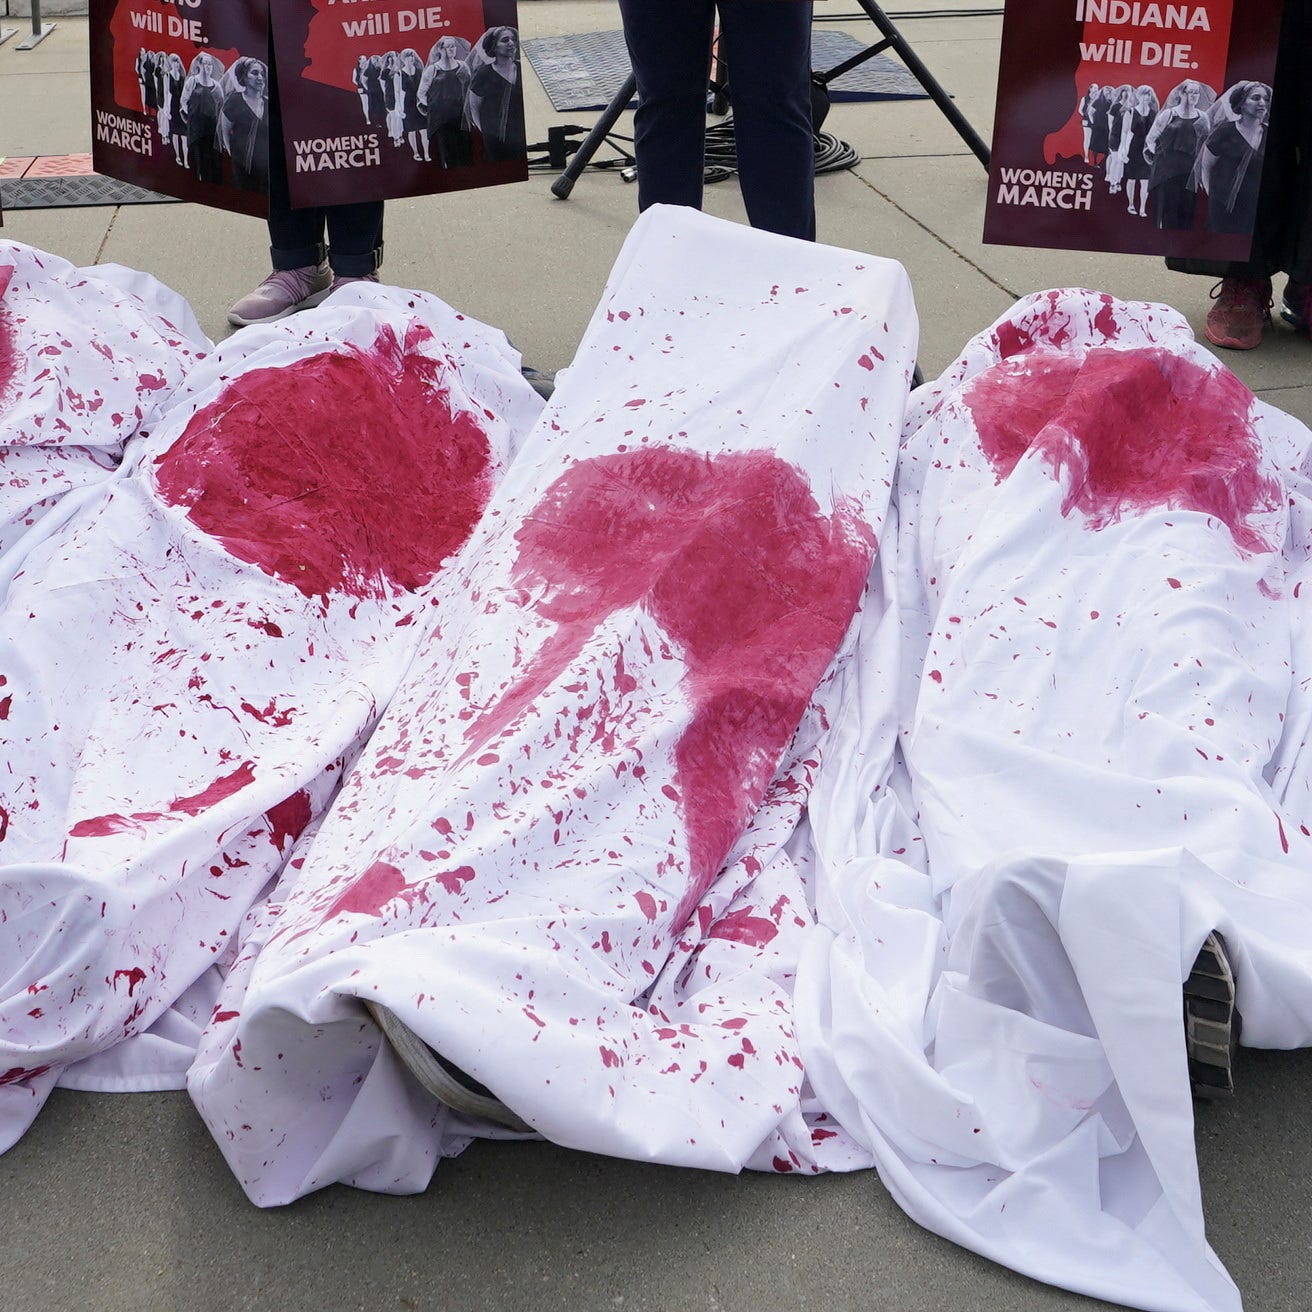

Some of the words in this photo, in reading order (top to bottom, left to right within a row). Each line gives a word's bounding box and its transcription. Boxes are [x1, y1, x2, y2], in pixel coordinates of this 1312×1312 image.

[130, 10, 162, 33] will
[168, 16, 208, 43] DIE.
[342, 13, 390, 37] will
[398, 7, 450, 31] DIE.
[1079, 38, 1132, 64] will
[1140, 42, 1198, 69] DIE.
[96, 109, 152, 139] WOMEN'S
[97, 123, 153, 157] MARCH
[293, 133, 379, 155] WOMEN'S
[295, 148, 380, 173] MARCH
[1000, 167, 1093, 190] WOMEN'S
[997, 184, 1092, 210] MARCH
